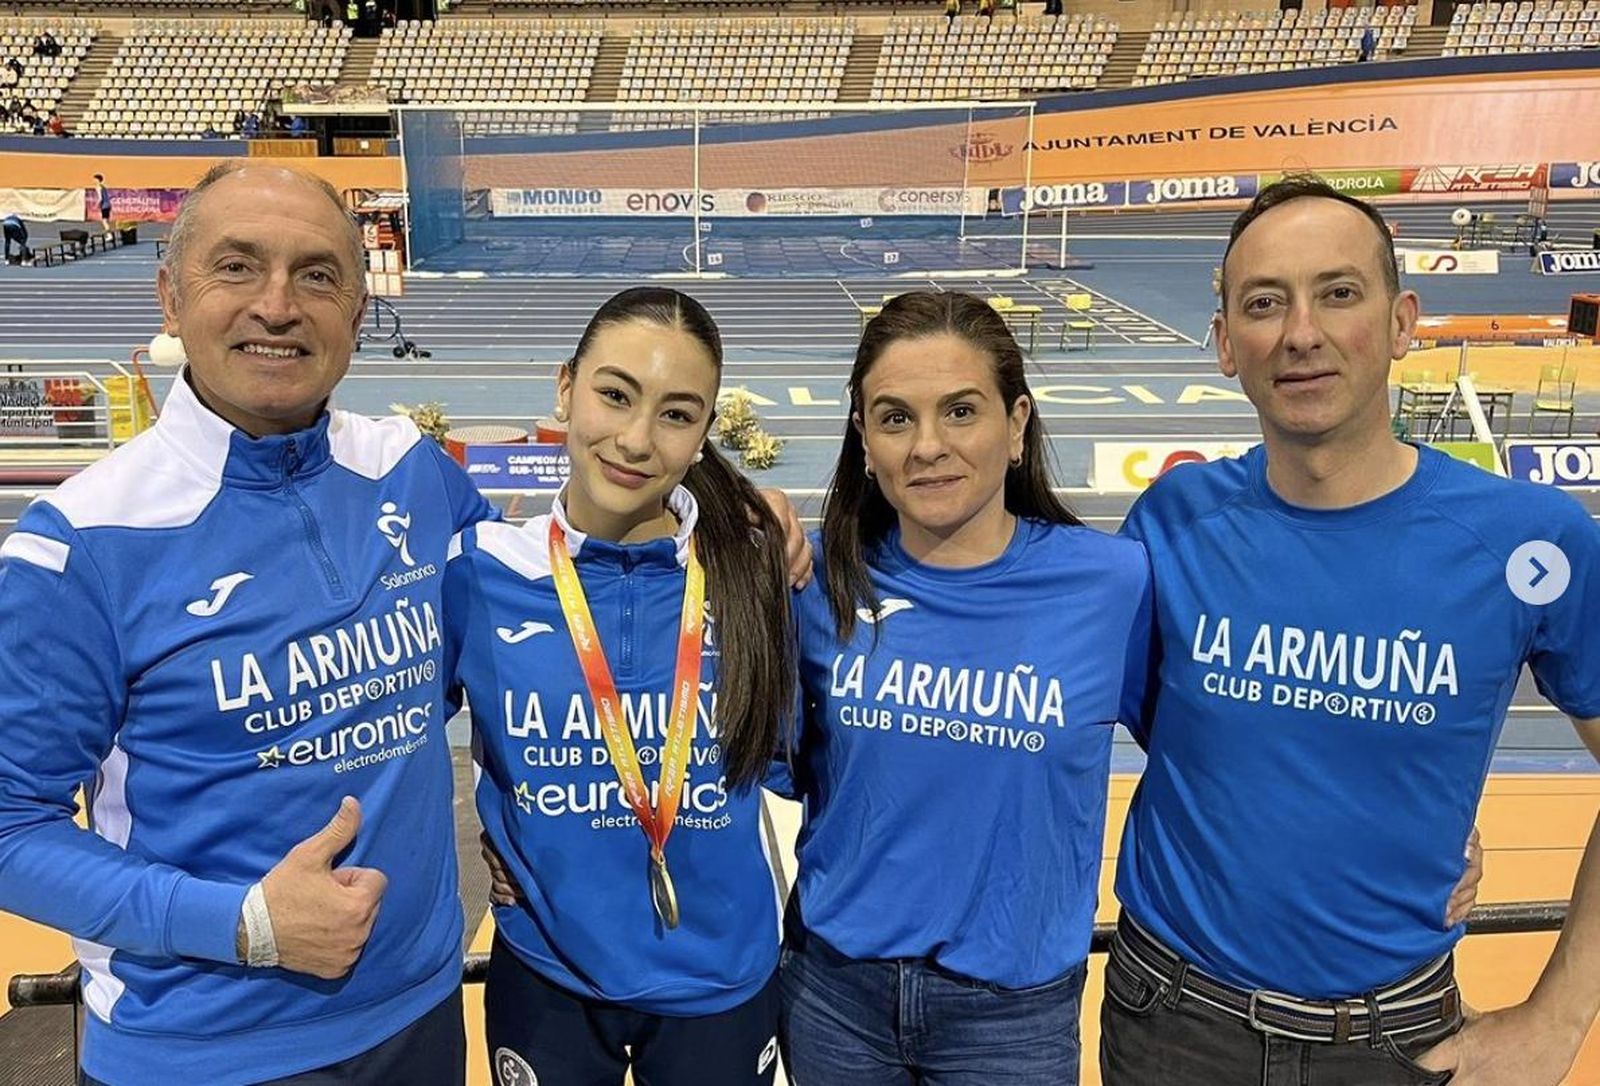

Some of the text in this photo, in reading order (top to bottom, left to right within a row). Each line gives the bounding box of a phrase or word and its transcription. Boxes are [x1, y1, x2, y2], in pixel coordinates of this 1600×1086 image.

[1022, 114, 1398, 152] AJUNTAMENT DE VALÈNCIA
[523, 189, 602, 205] MONDO
[627, 190, 714, 212] enovs
[1326, 176, 1385, 190] RDROLA
[1490, 320, 1500, 331] 6
[211, 597, 442, 711] LA ARMUÑA
[1192, 614, 1459, 696] LA ARMUÑA
[244, 659, 436, 734] CLUB DEPORTIVO
[504, 682, 725, 740] LA AMUÑ
[831, 653, 1065, 727] LA ARMUÑA
[1203, 672, 1437, 726] CLUB DEPORTIVO
[839, 705, 1045, 753] CLUB DEPORTIVO
[523, 746, 583, 766] CLUB
